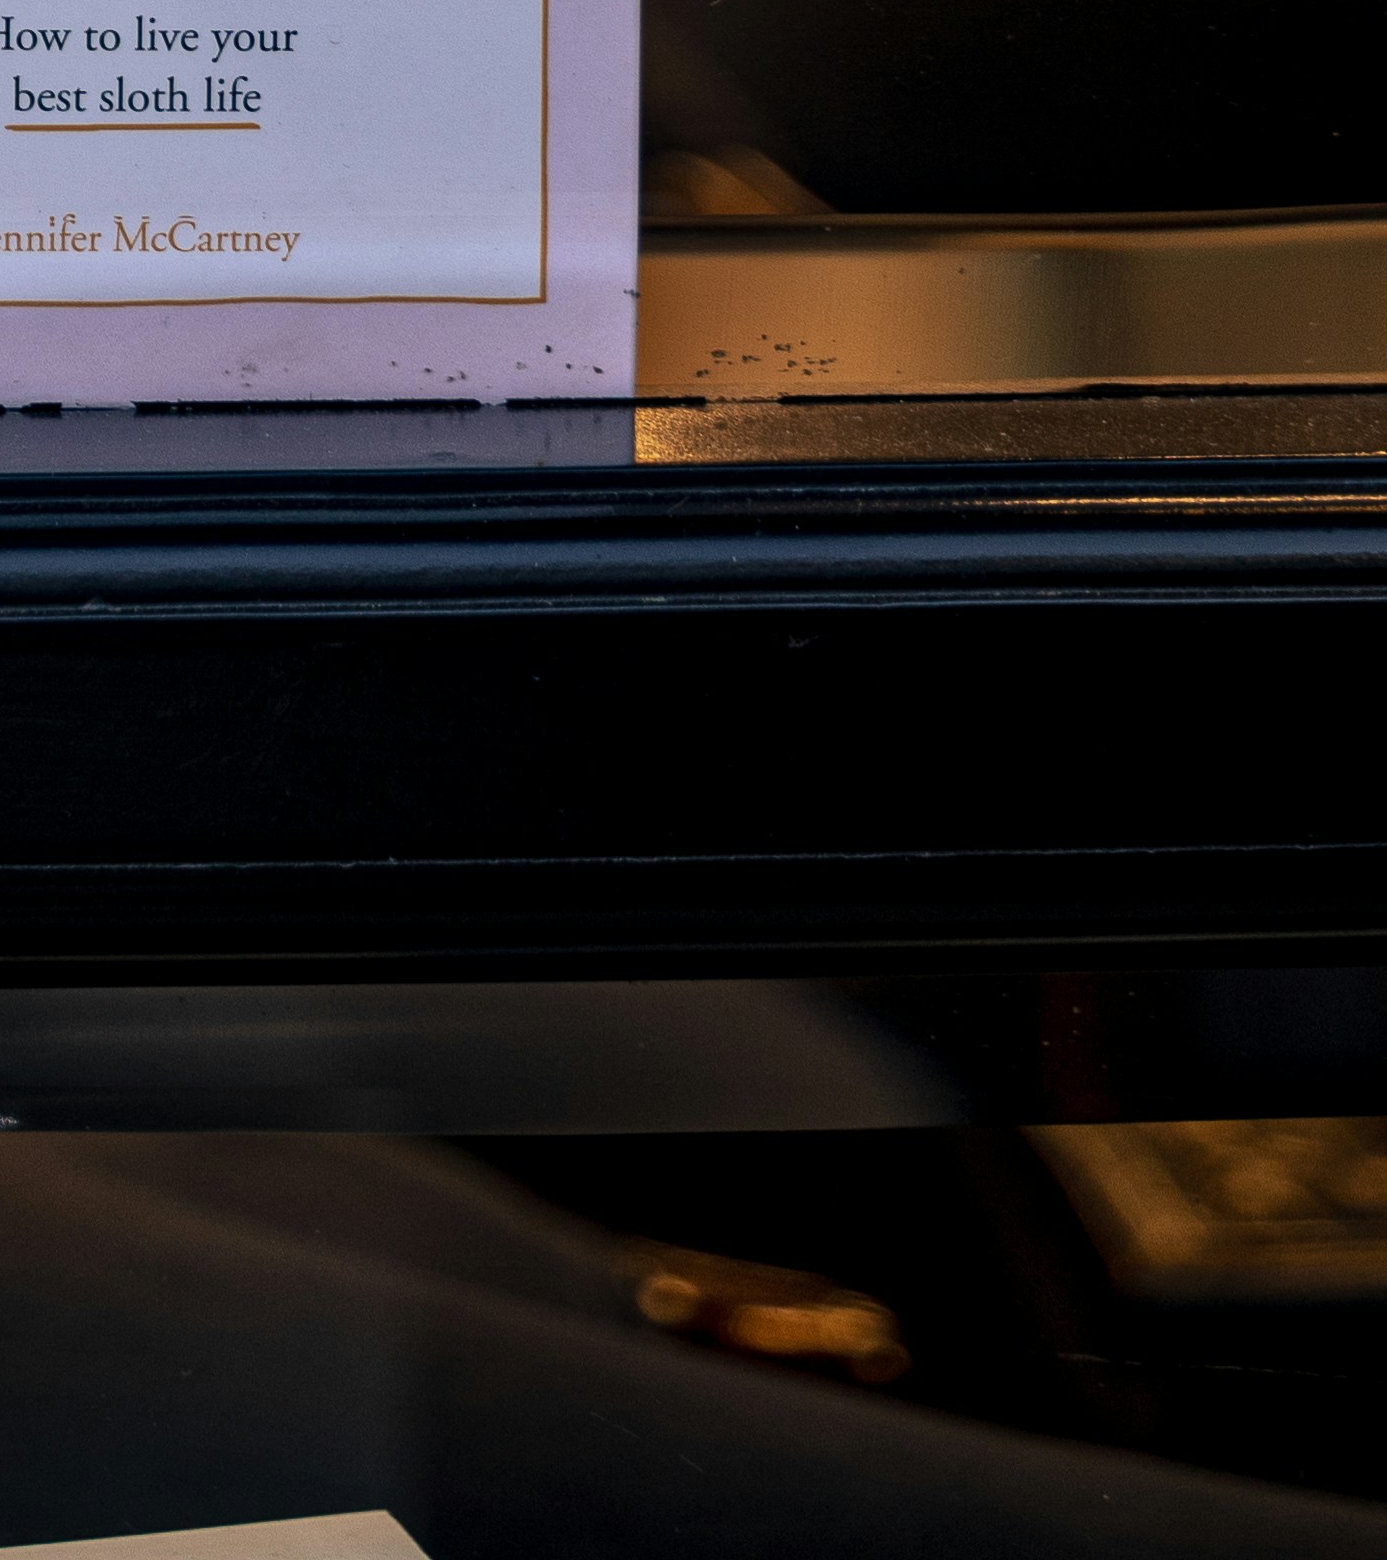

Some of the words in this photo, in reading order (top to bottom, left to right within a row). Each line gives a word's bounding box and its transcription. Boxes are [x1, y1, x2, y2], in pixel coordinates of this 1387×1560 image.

[84, 25, 122, 52] to
[135, 14, 200, 52] live
[210, 26, 300, 64] your
[12, 74, 88, 113] best
[98, 75, 191, 113] sloth
[202, 75, 262, 113] life
[112, 214, 301, 263] McCartney
